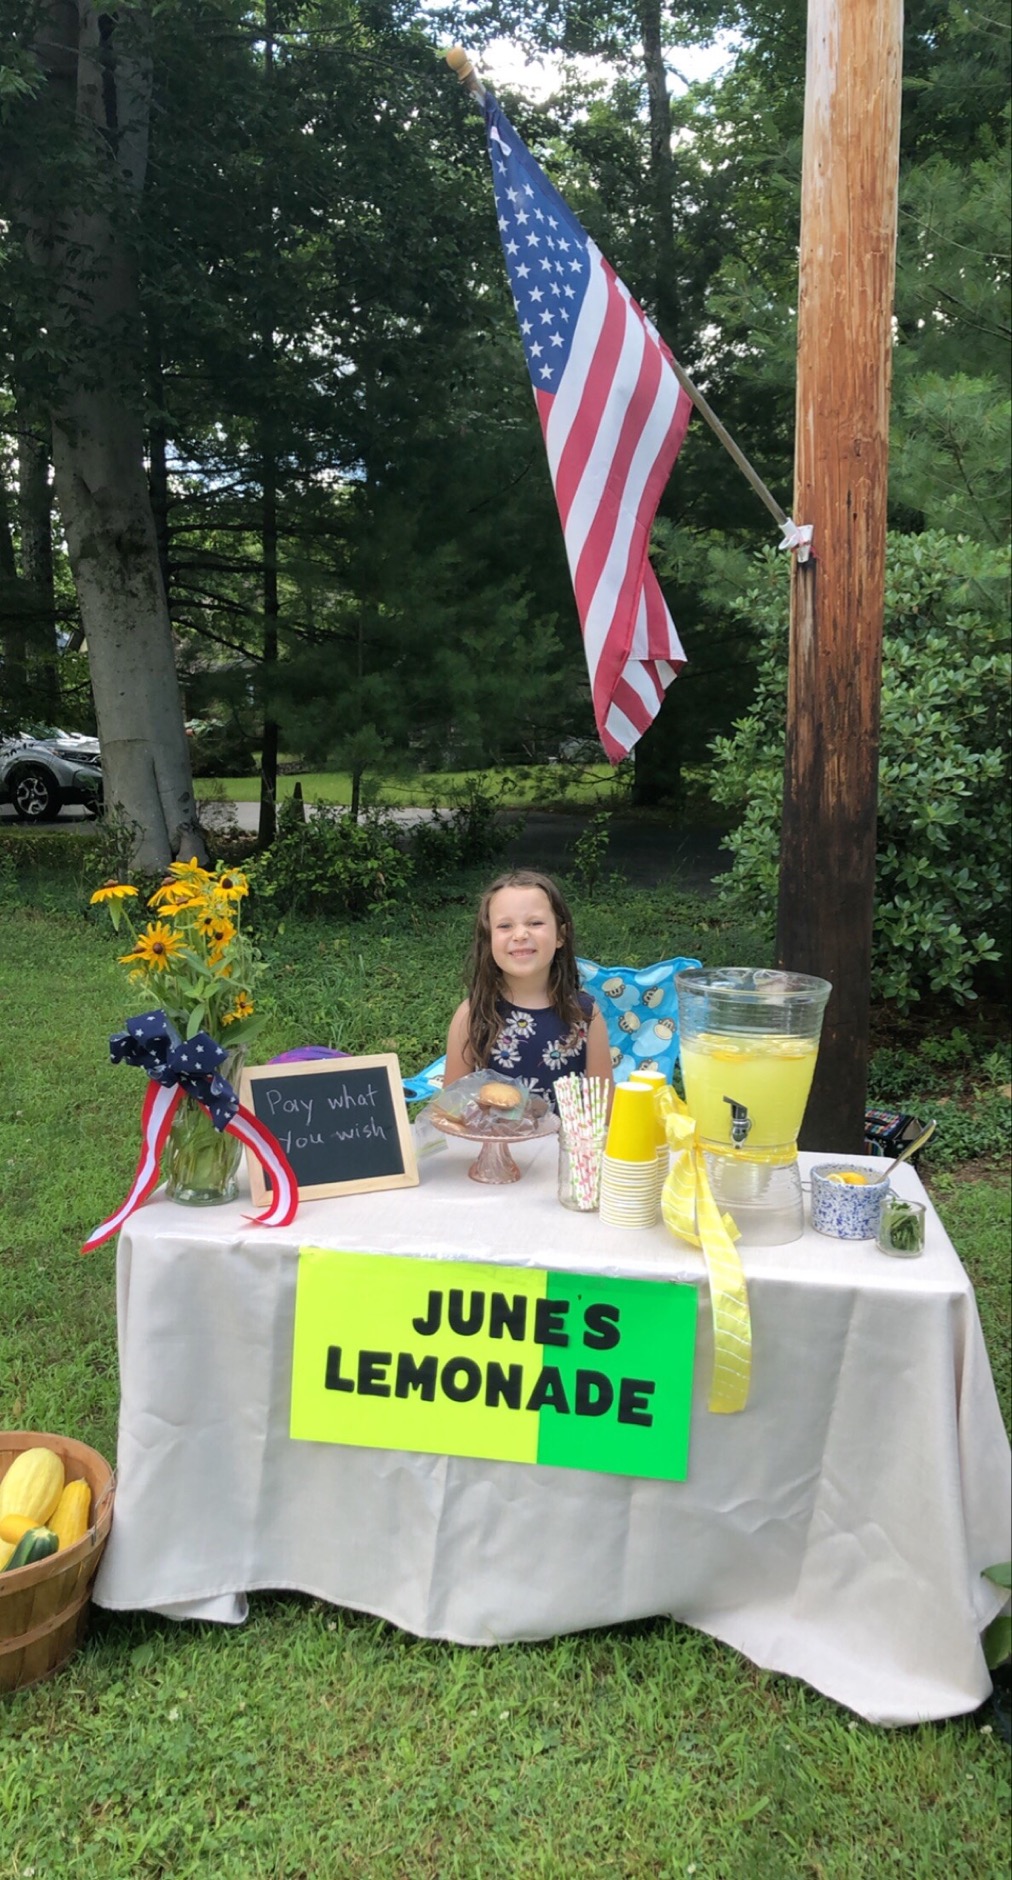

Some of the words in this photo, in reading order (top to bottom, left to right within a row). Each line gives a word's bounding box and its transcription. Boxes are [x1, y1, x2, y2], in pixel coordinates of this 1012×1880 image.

[266, 1089, 313, 1126] Pay
[327, 1083, 378, 1110] what
[335, 1116, 387, 1141] wish
[324, 1345, 656, 1427] LEMONADE
